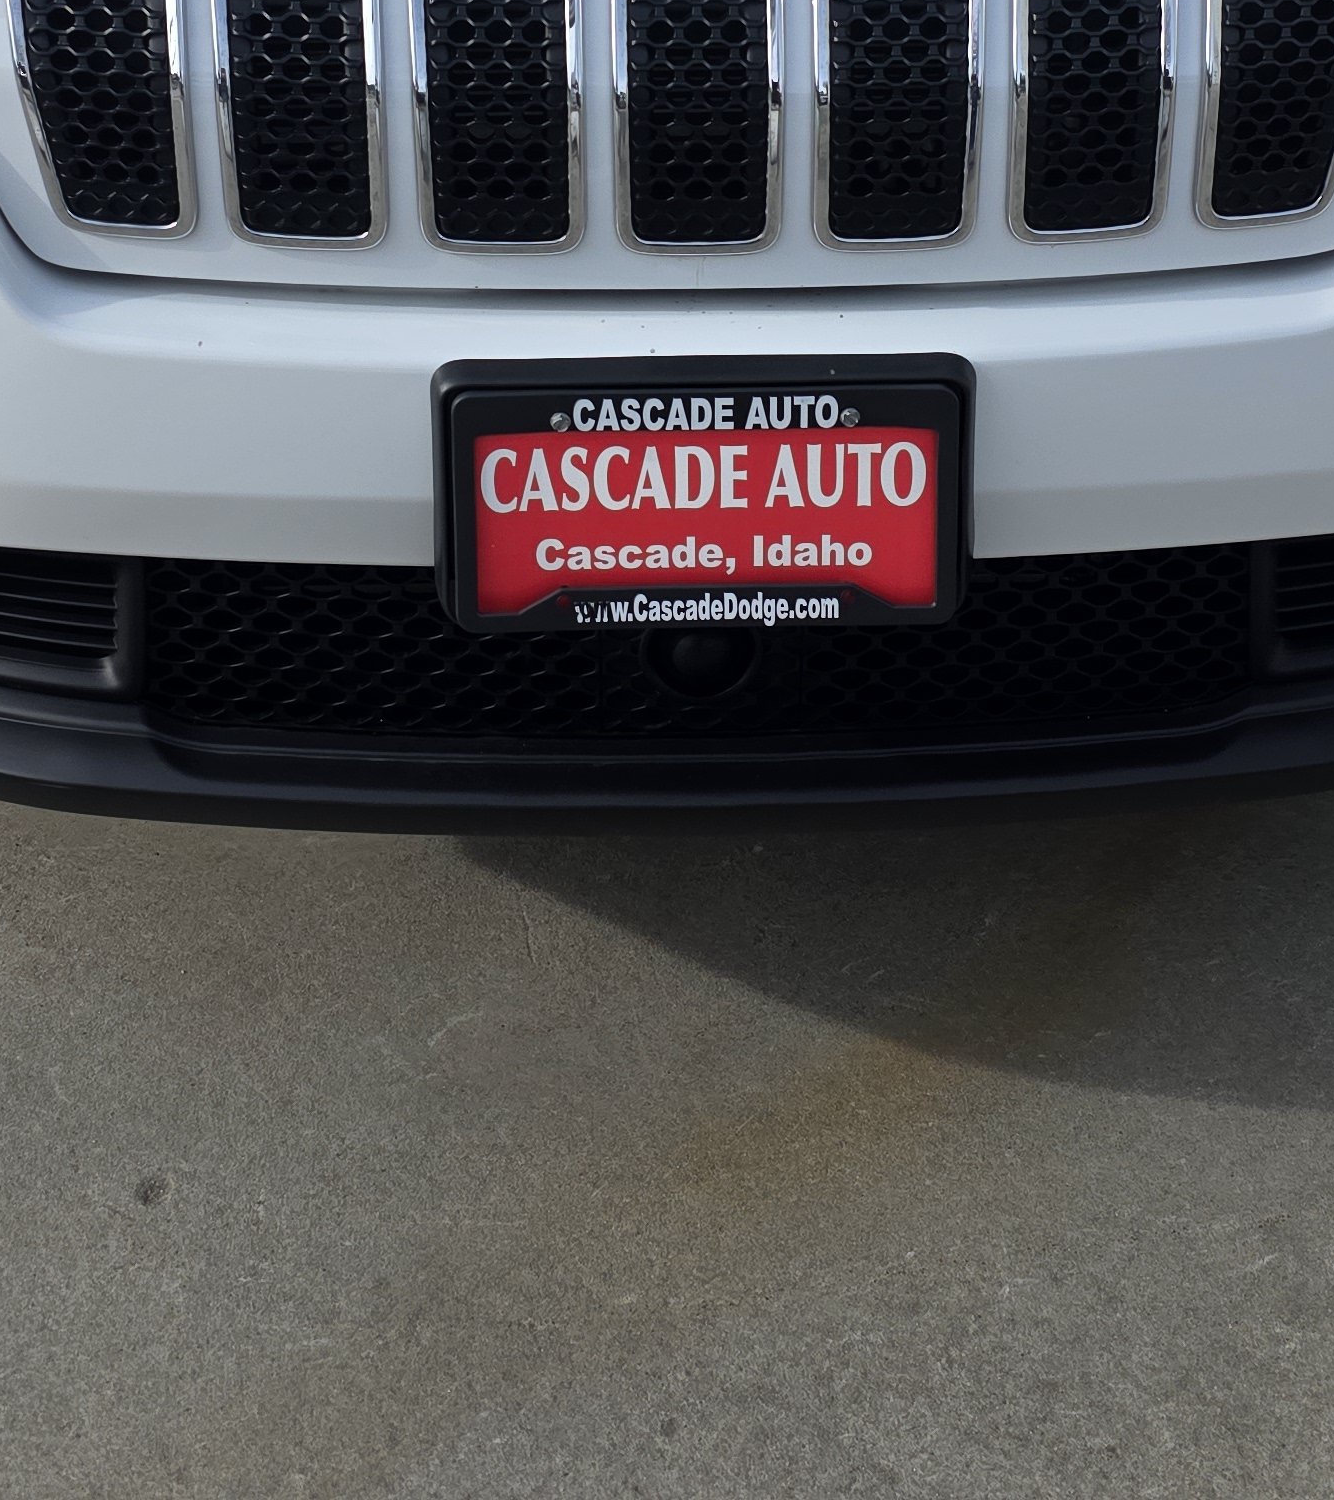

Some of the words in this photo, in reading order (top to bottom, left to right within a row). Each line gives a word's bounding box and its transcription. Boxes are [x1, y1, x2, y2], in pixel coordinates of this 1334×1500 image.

[573, 397, 735, 431] CASCADE
[744, 395, 839, 430] AUTO
[480, 444, 749, 514] CASCADE
[764, 441, 927, 508] AUTO
[535, 536, 736, 575] Cascade,
[753, 534, 873, 567] Idaho
